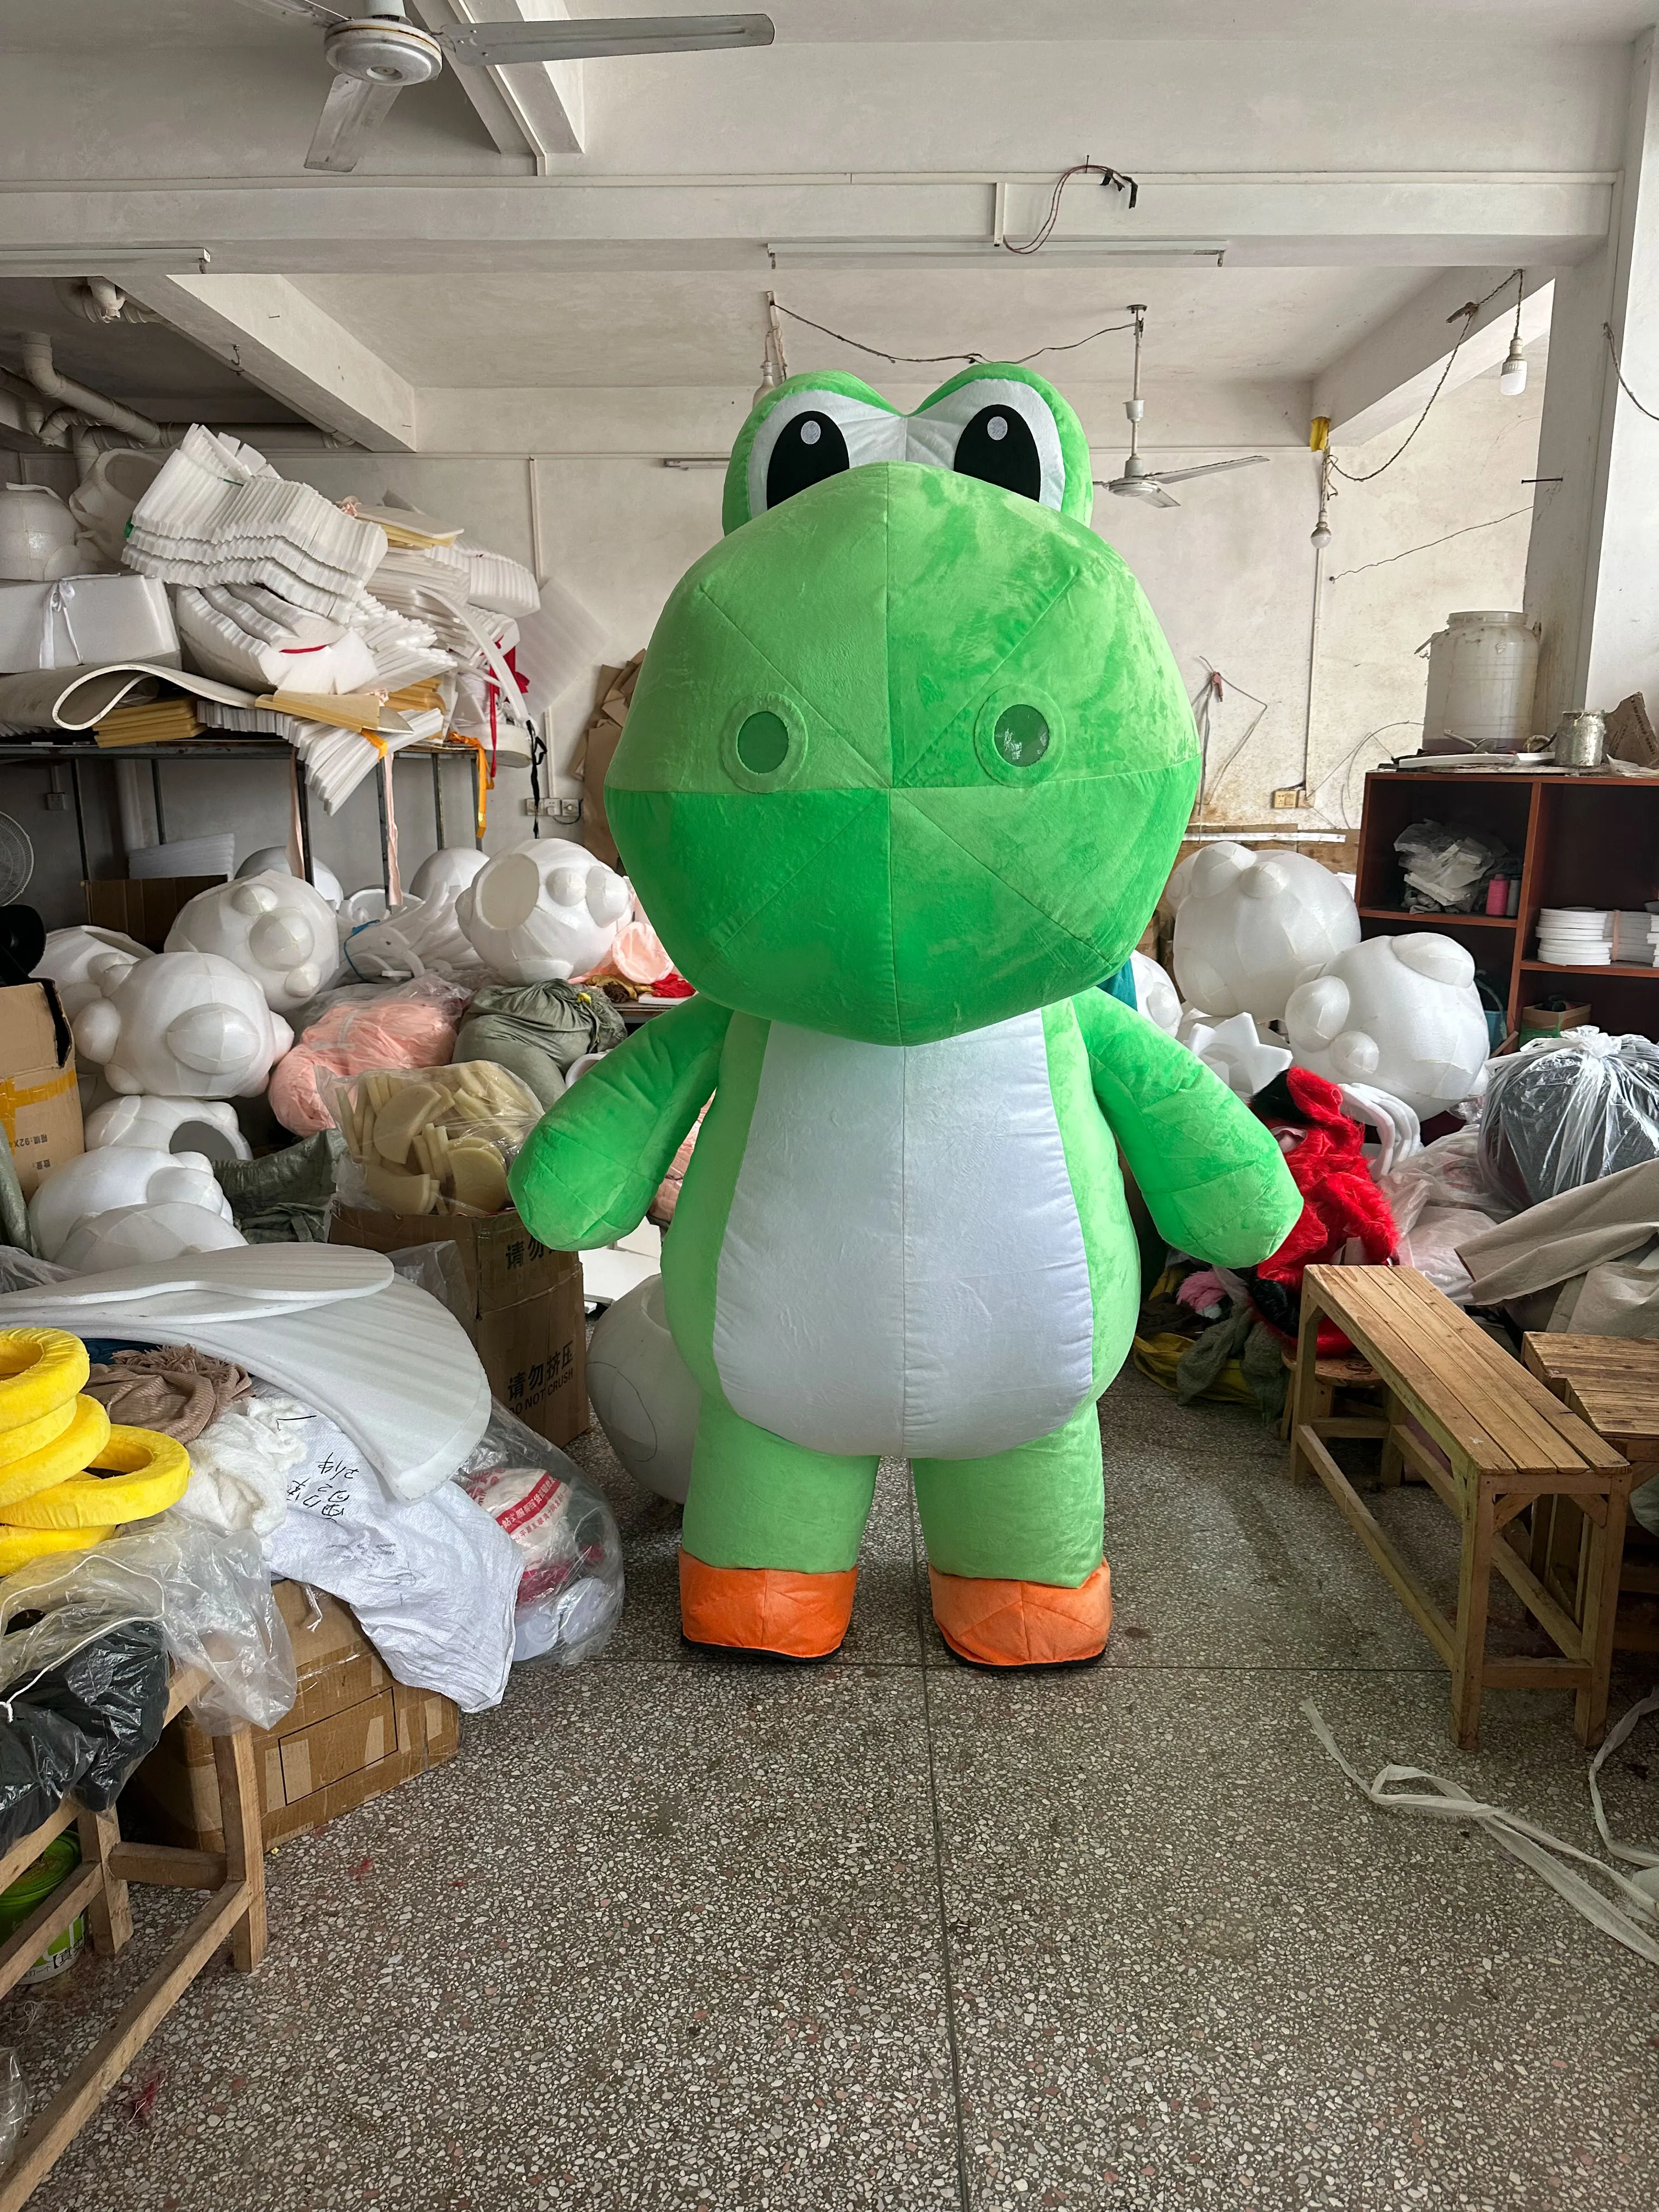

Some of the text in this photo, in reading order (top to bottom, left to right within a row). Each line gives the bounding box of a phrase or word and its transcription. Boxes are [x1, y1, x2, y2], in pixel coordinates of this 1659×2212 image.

[507, 1340, 573, 1402] 请勿挤压
[525, 1388, 546, 1410] NOT
[548, 1367, 574, 1396] CRUSH
